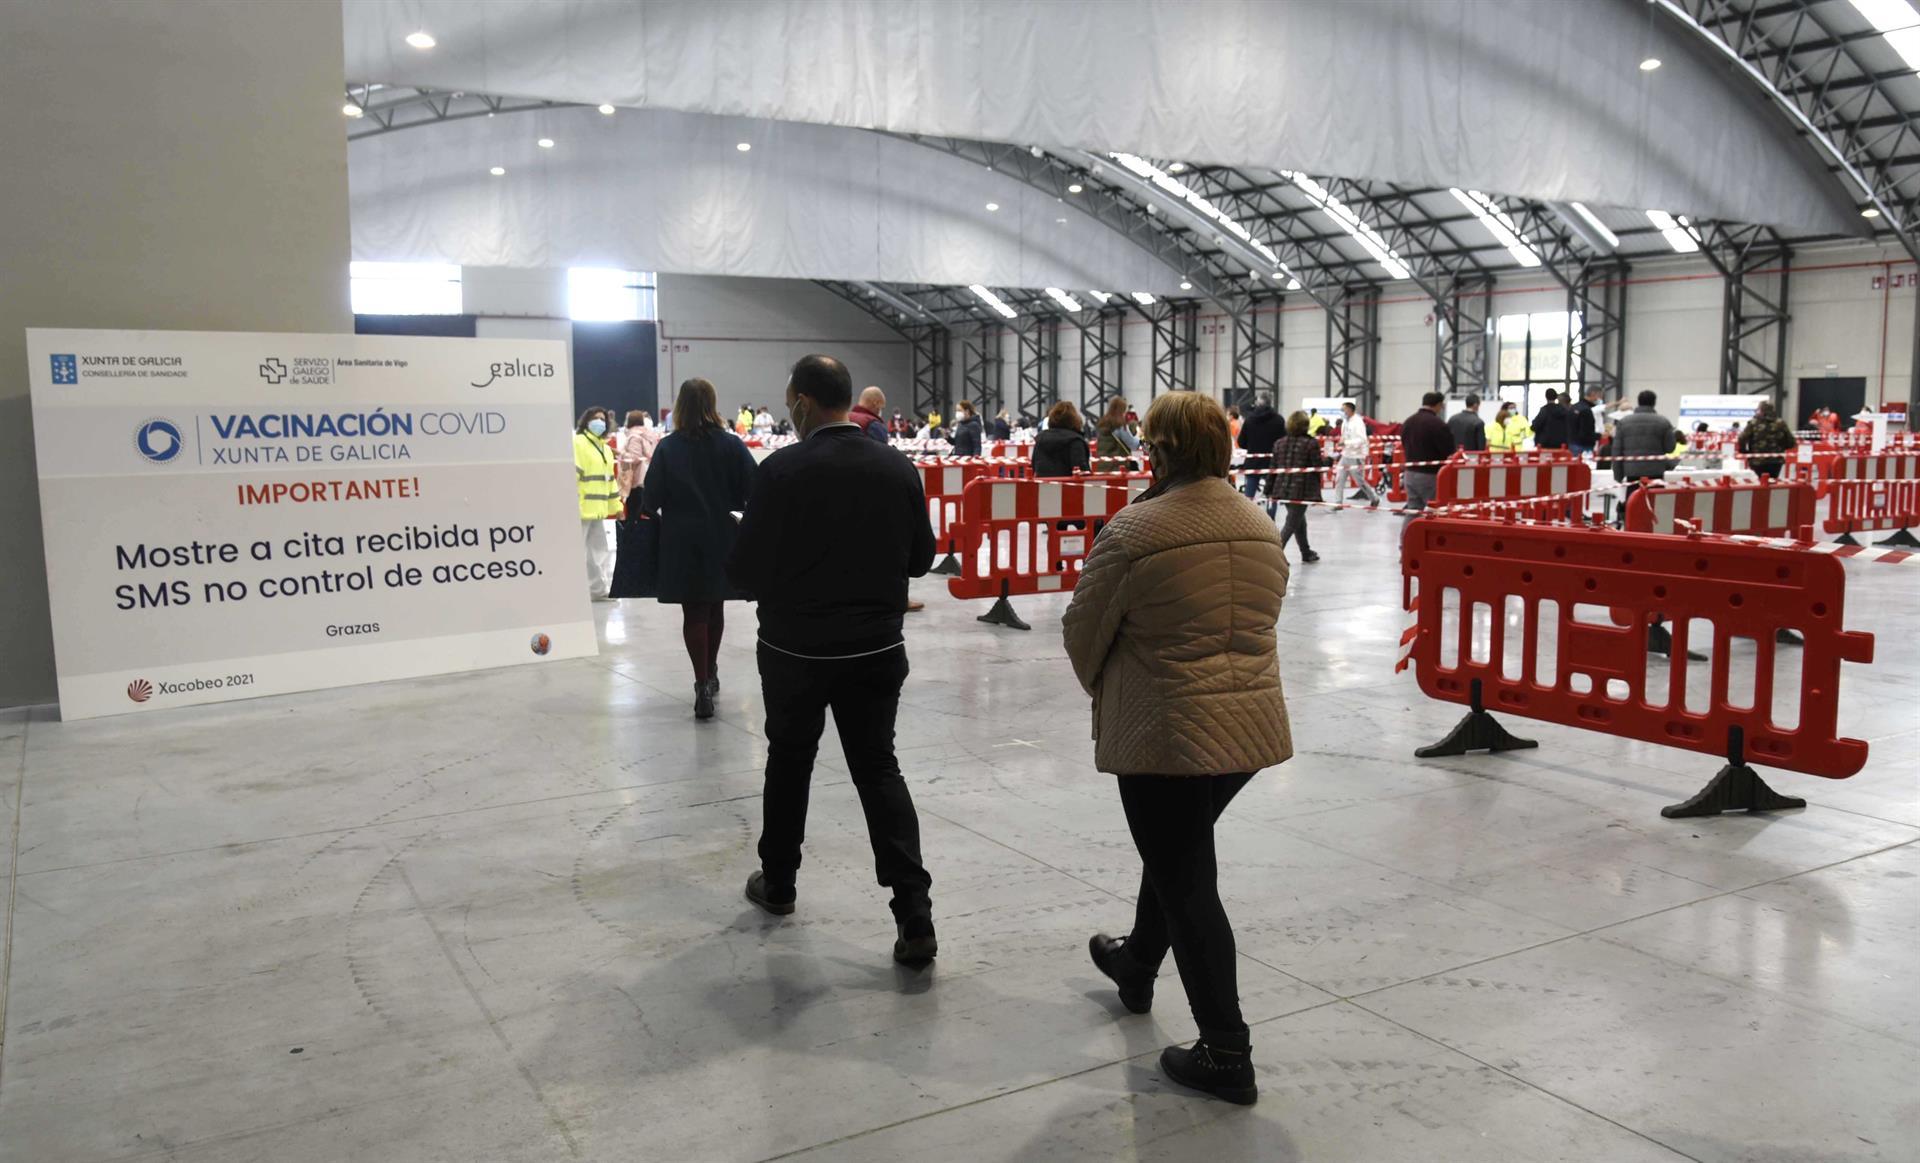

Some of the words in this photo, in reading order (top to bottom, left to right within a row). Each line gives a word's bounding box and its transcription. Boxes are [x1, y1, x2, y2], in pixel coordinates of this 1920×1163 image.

[82, 356, 120, 366] XUNTA
[122, 356, 135, 366] DE
[138, 356, 183, 367] GALICIA
[294, 358, 329, 367] SERVIZO
[354, 358, 383, 367] Sanitaria
[385, 359, 393, 367] de
[394, 359, 409, 368] Vigo
[138, 370, 148, 378] DE
[150, 370, 188, 378] SANIDADE
[290, 376, 300, 385] de
[293, 367, 330, 376] GALEGO
[471, 358, 554, 388] galicia
[210, 407, 413, 439] VACINACIÓN
[420, 411, 506, 436] COVID
[213, 446, 289, 465] XUNTA
[296, 446, 324, 463] DE
[330, 444, 411, 462] GALICIA
[238, 477, 420, 505] IMPORTANTE!
[116, 540, 239, 570] Mostre
[250, 540, 273, 561] a
[284, 532, 345, 558] cita
[356, 524, 479, 554] recibida
[489, 524, 535, 552] por
[115, 580, 191, 610] SMS
[204, 581, 247, 603] no
[259, 565, 374, 598] control
[384, 563, 423, 588] de
[432, 558, 543, 584] acceso.
[326, 621, 380, 637] Grazas
[158, 678, 223, 695] Xacobeo
[226, 674, 254, 687] 2021
